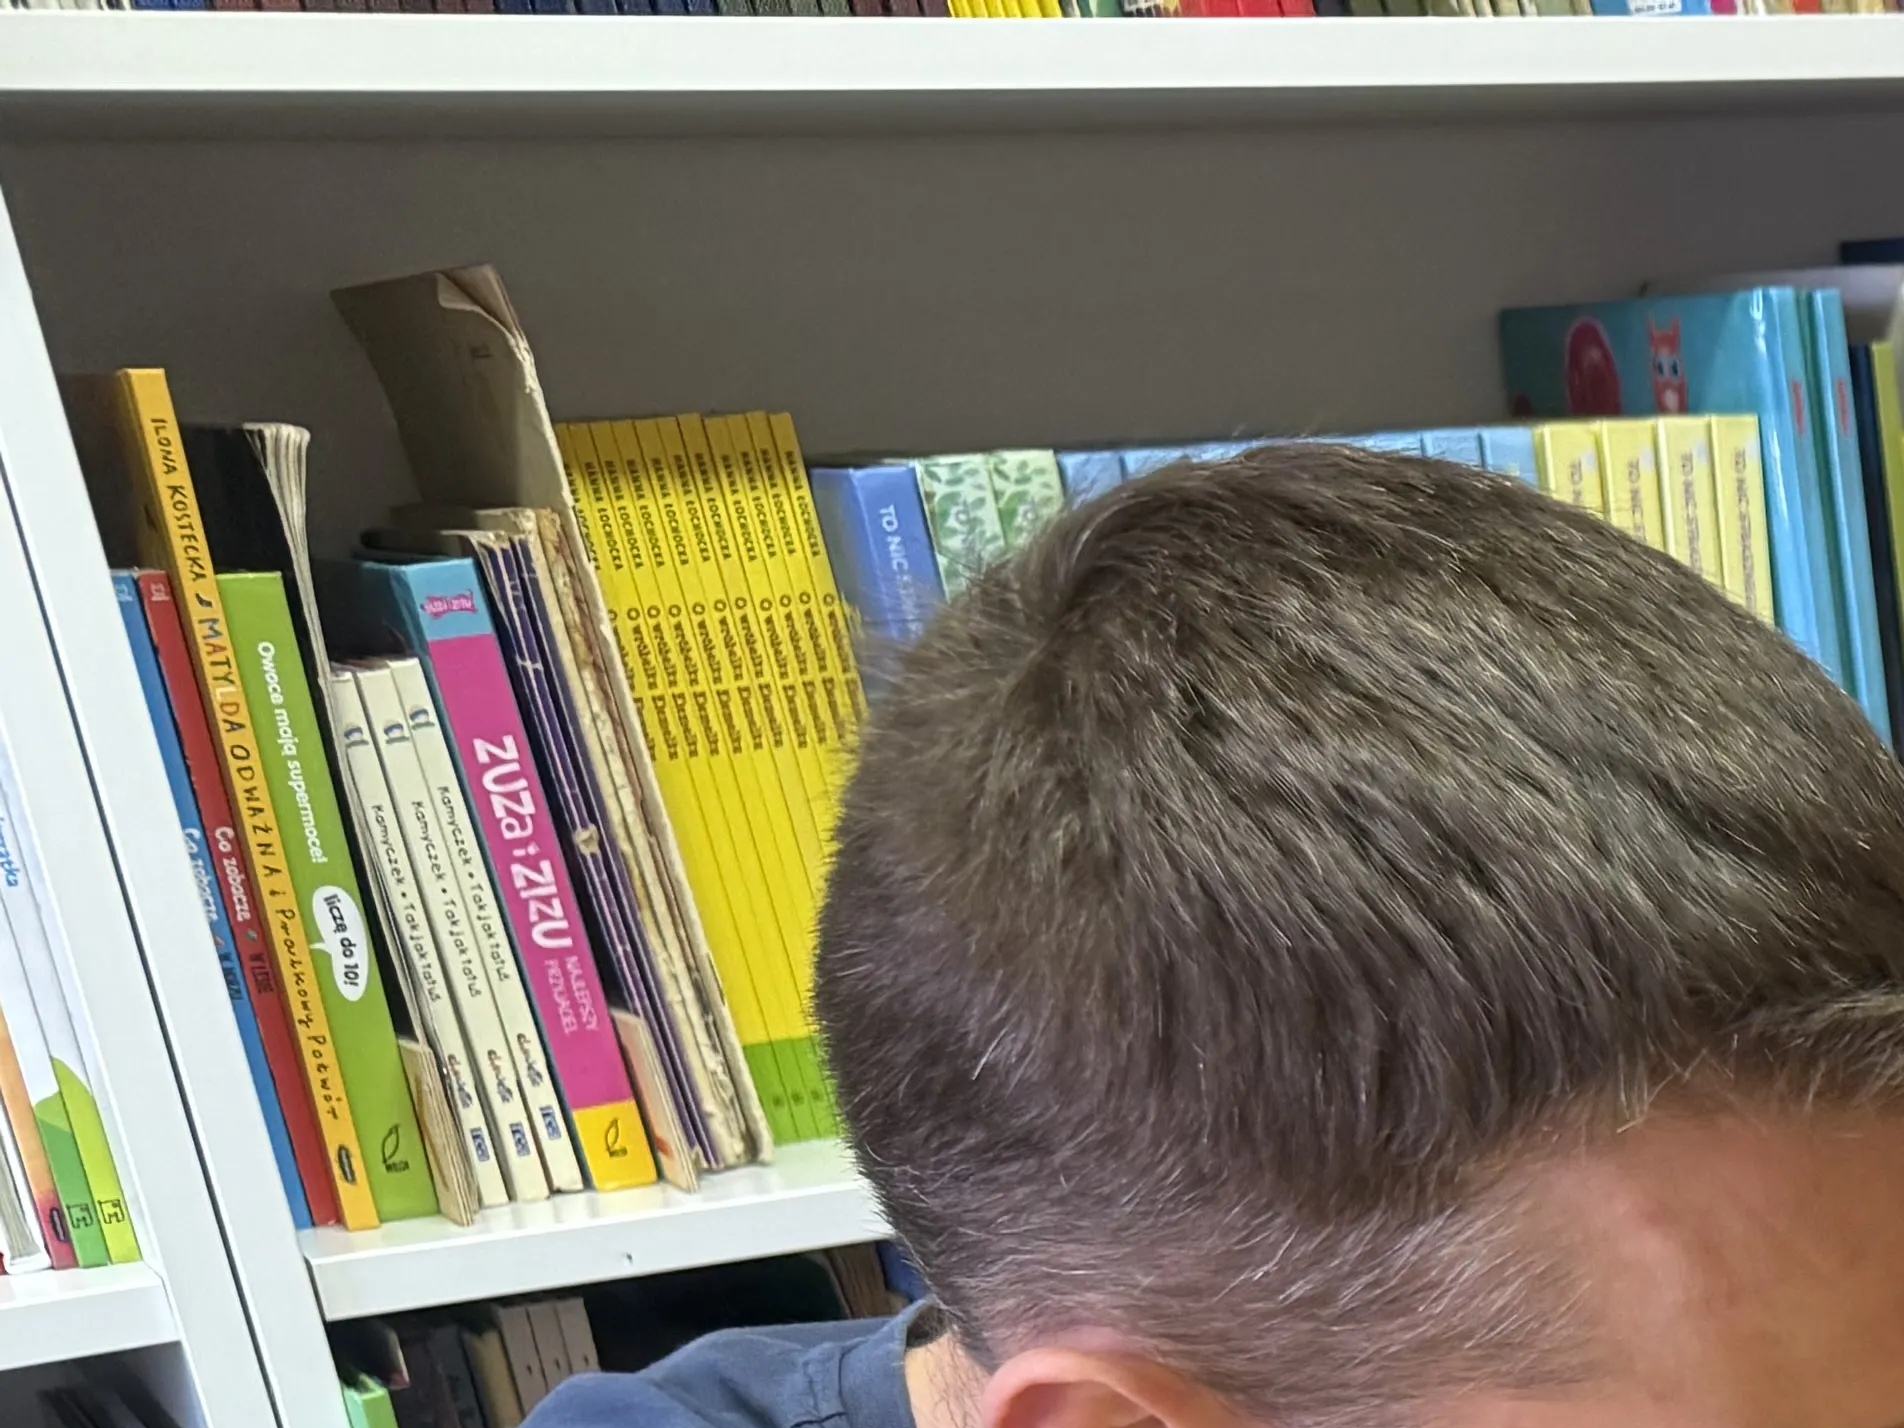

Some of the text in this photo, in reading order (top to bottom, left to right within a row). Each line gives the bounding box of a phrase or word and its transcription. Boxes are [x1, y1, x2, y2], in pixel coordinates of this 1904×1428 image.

[150, 417, 178, 476] ILONA
[167, 485, 208, 583] KOSTECKA
[198, 616, 243, 734] MATYLDA
[256, 641, 329, 864] Owoce mają supermoce!
[214, 825, 237, 849] Co
[370, 804, 406, 888] Kamyczek
[402, 902, 425, 937] Tak
[411, 800, 446, 884] Kamyczek
[441, 896, 465, 930] Tak
[436, 785, 475, 869] Kamyczek
[469, 881, 495, 916] Tak
[322, 893, 360, 989] liczę do 10!
[508, 860, 574, 950] ZIZU
